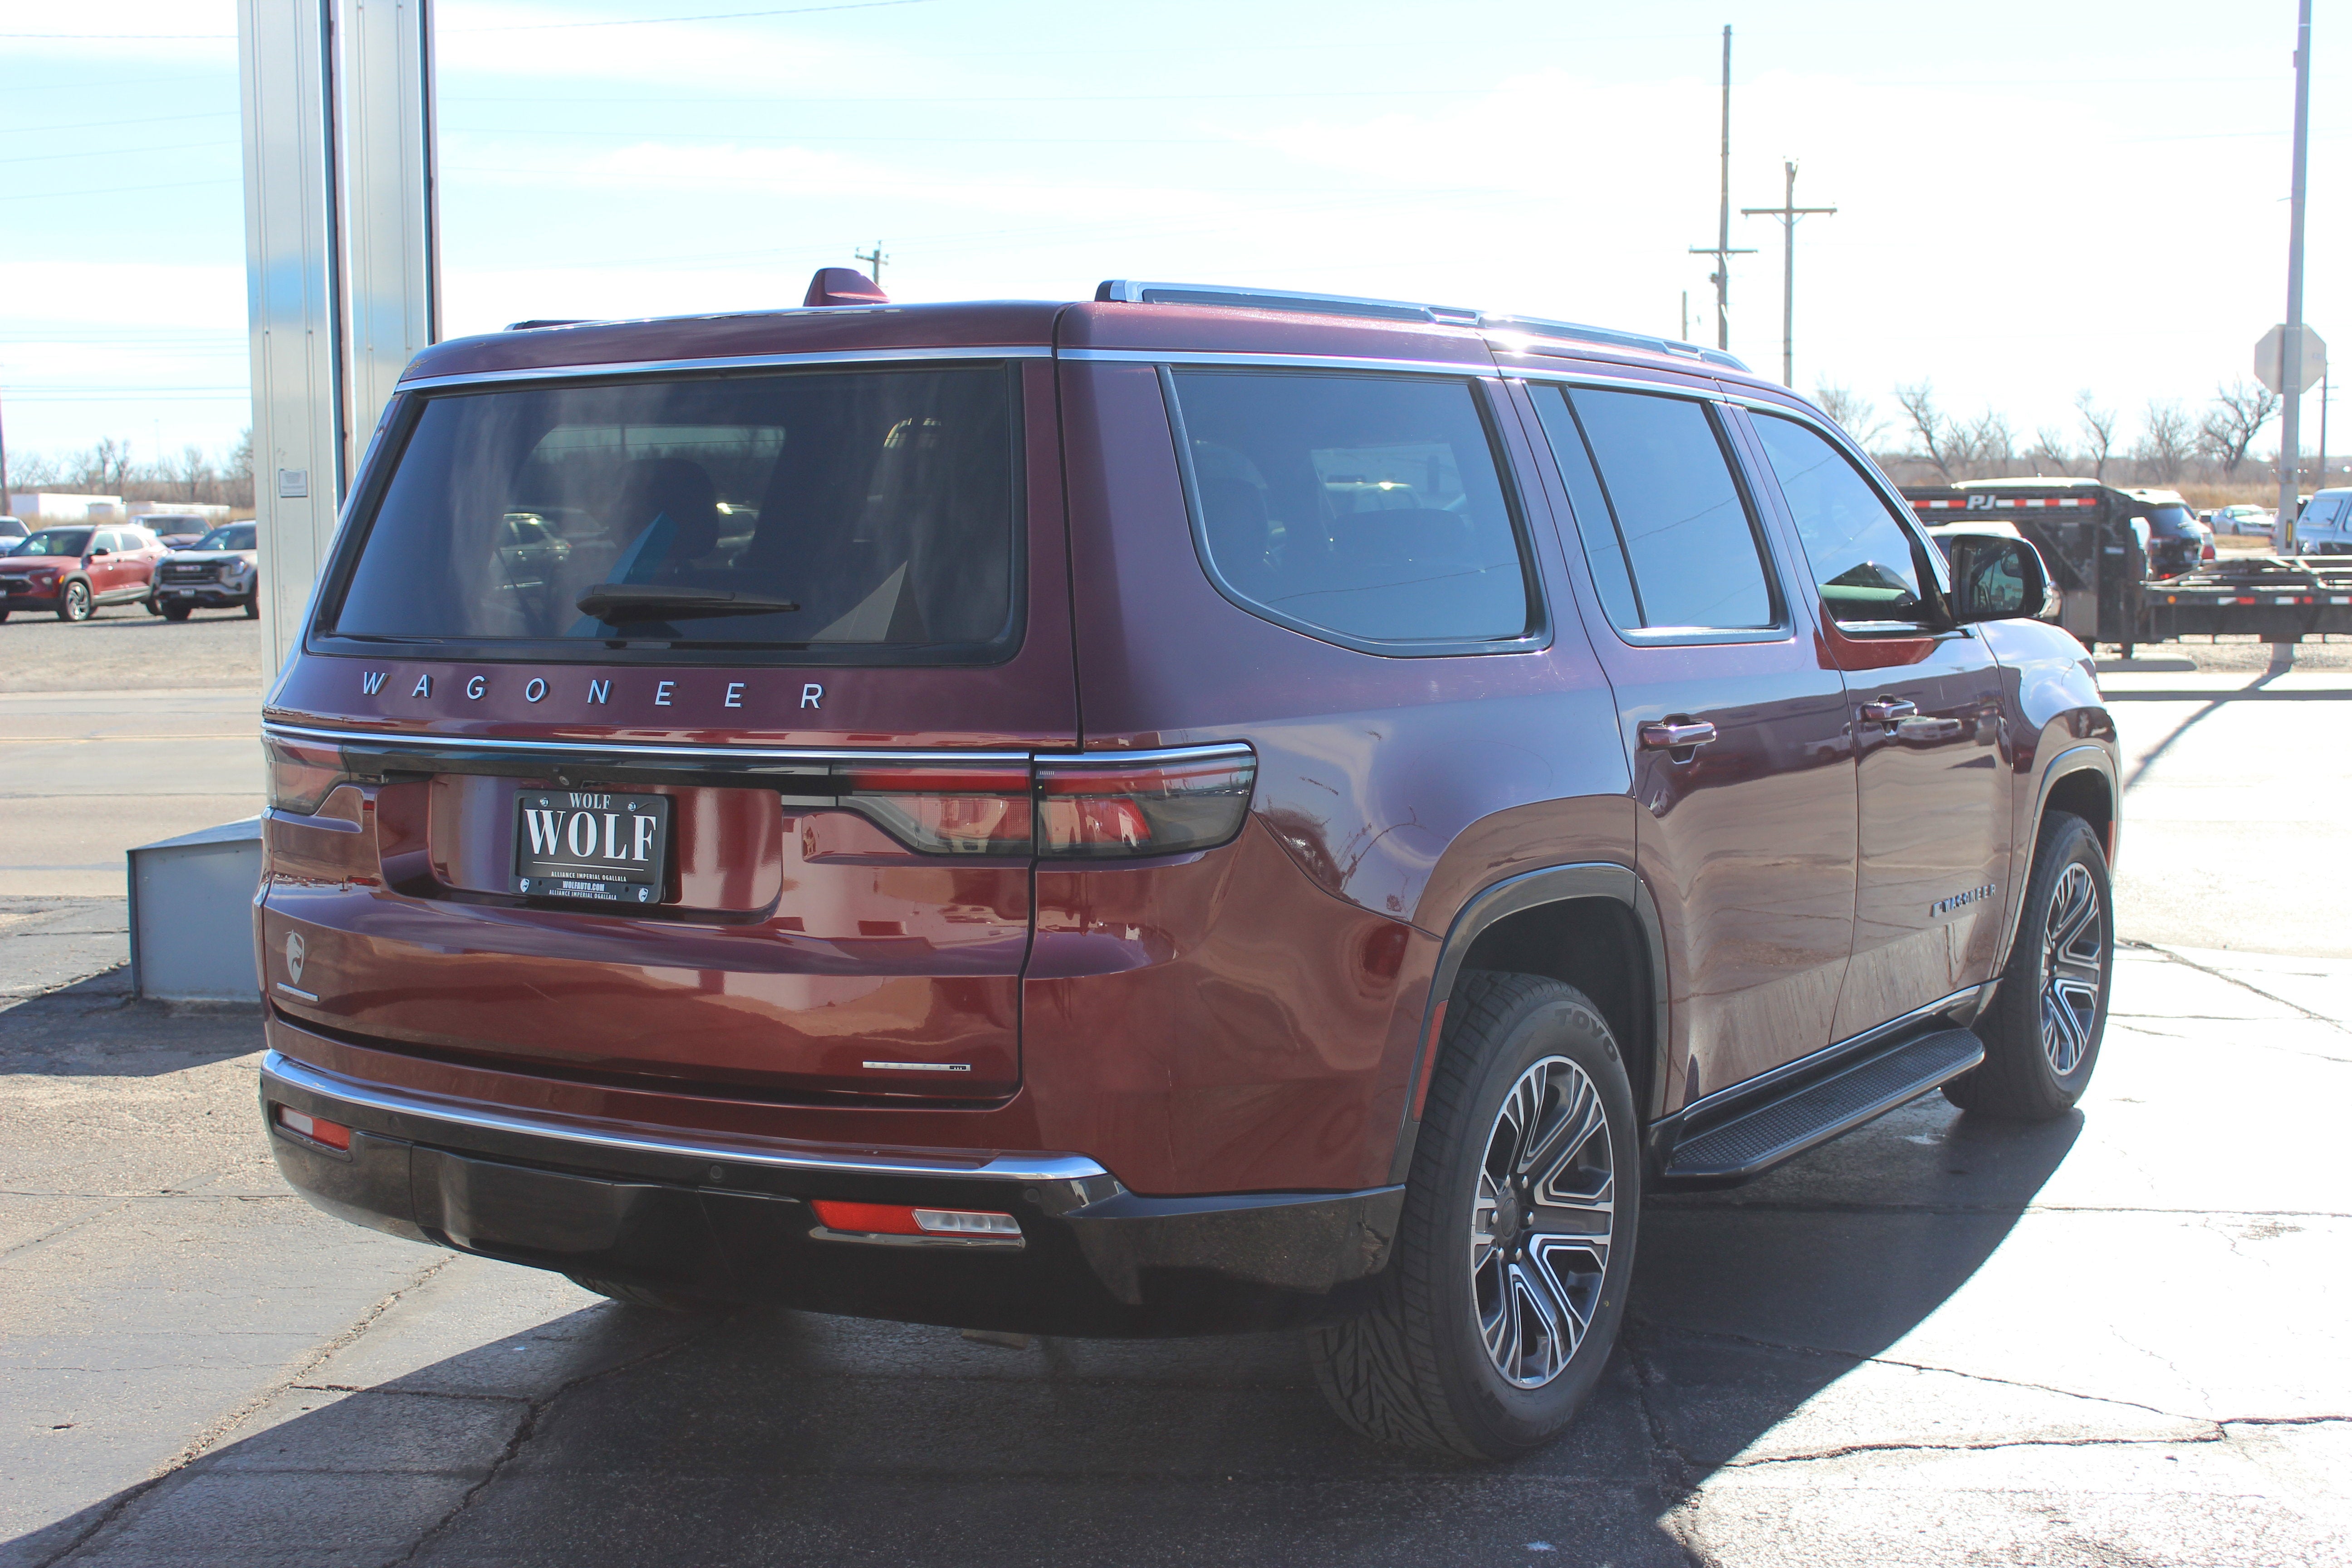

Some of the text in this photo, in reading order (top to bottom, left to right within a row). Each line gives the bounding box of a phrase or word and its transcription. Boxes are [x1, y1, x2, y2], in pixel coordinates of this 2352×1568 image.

[1966, 495, 1996, 510] PJ
[363, 671, 826, 710] WAGONEER
[569, 792, 611, 809] WOLF
[525, 809, 657, 862] WOLF
[577, 872, 600, 881] IMPERIAL
[563, 880, 605, 892] WOLFAUTO.COM
[594, 892, 617, 901] OGALLALA
[1554, 1007, 1618, 1063] TOYO
